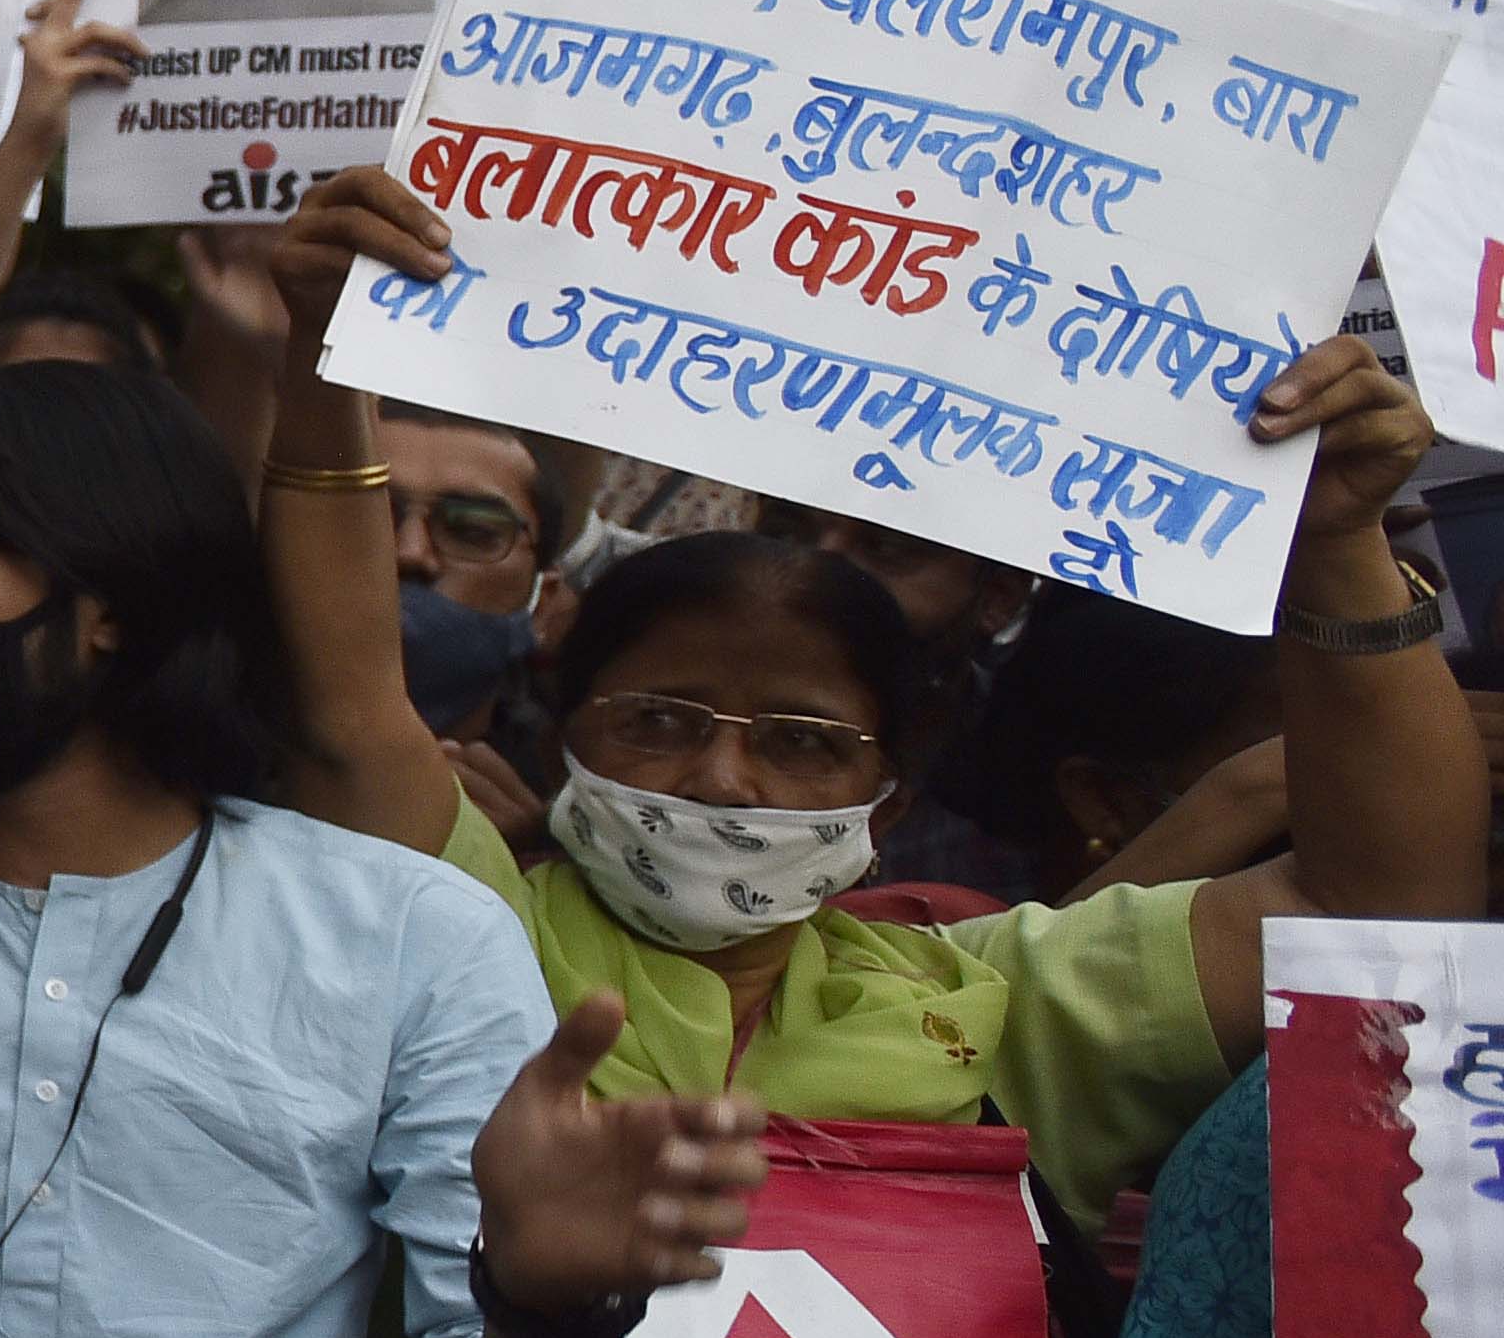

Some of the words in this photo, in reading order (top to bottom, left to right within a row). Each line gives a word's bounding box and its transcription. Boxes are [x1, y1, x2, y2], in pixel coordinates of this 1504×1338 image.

[208, 44, 241, 75] UP
[248, 43, 292, 74] CM
[298, 41, 371, 73] must
[1212, 55, 1359, 162] बारा
[408, 117, 777, 276] बलात्कार
[772, 189, 980, 317] कांड
[968, 233, 1053, 336] के
[506, 286, 1060, 491] उदाहरणमूलक
[1048, 433, 1267, 559] सजा
[1048, 519, 1142, 599] दो
